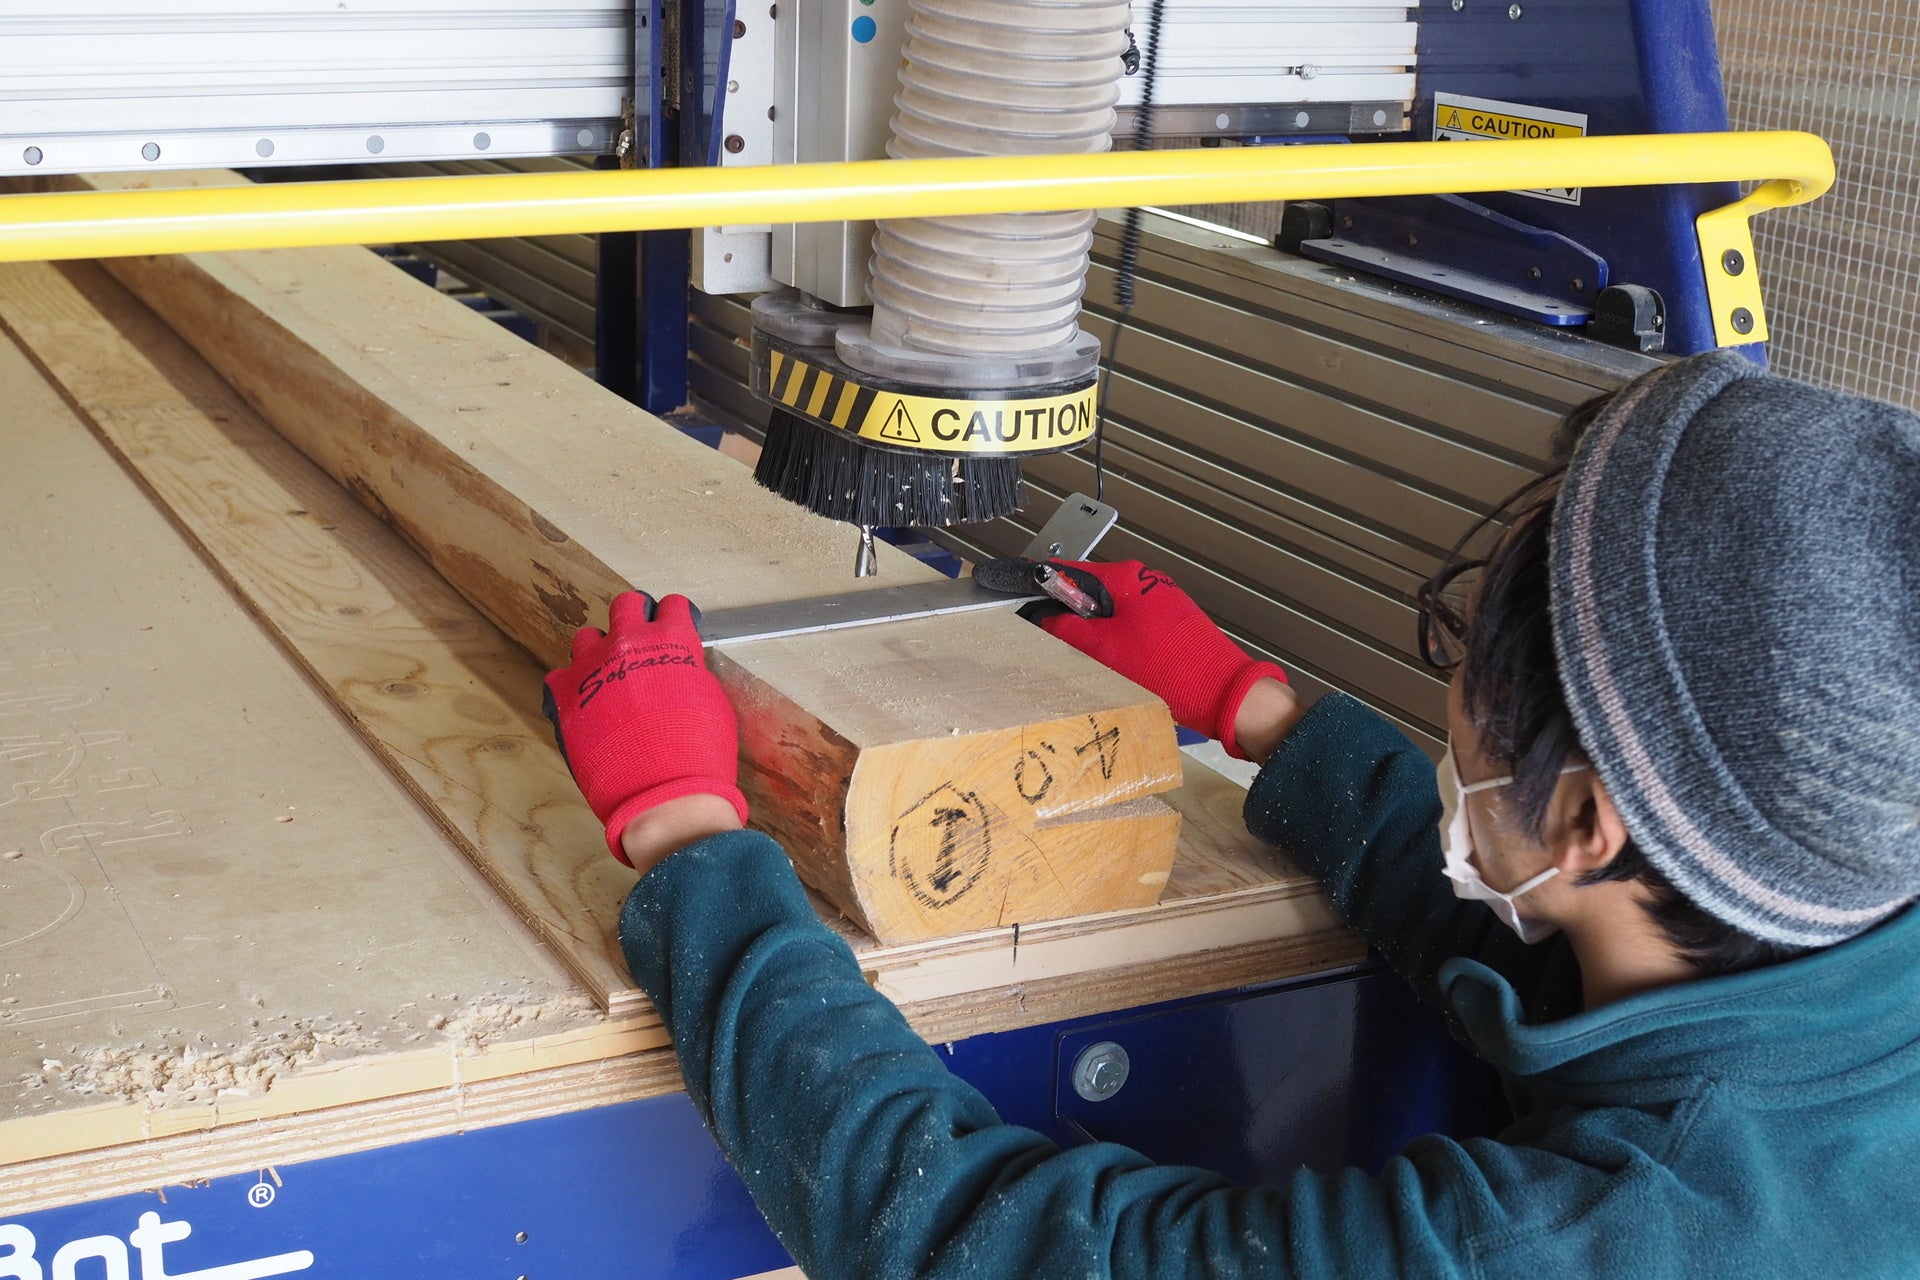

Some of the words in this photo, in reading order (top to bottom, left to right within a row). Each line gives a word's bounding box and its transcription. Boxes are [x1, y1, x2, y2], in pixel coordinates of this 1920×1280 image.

[1471, 115, 1556, 138] CAUTION
[931, 397, 1092, 442] CAUTION
[604, 642, 691, 667] PROFESSIONAL
